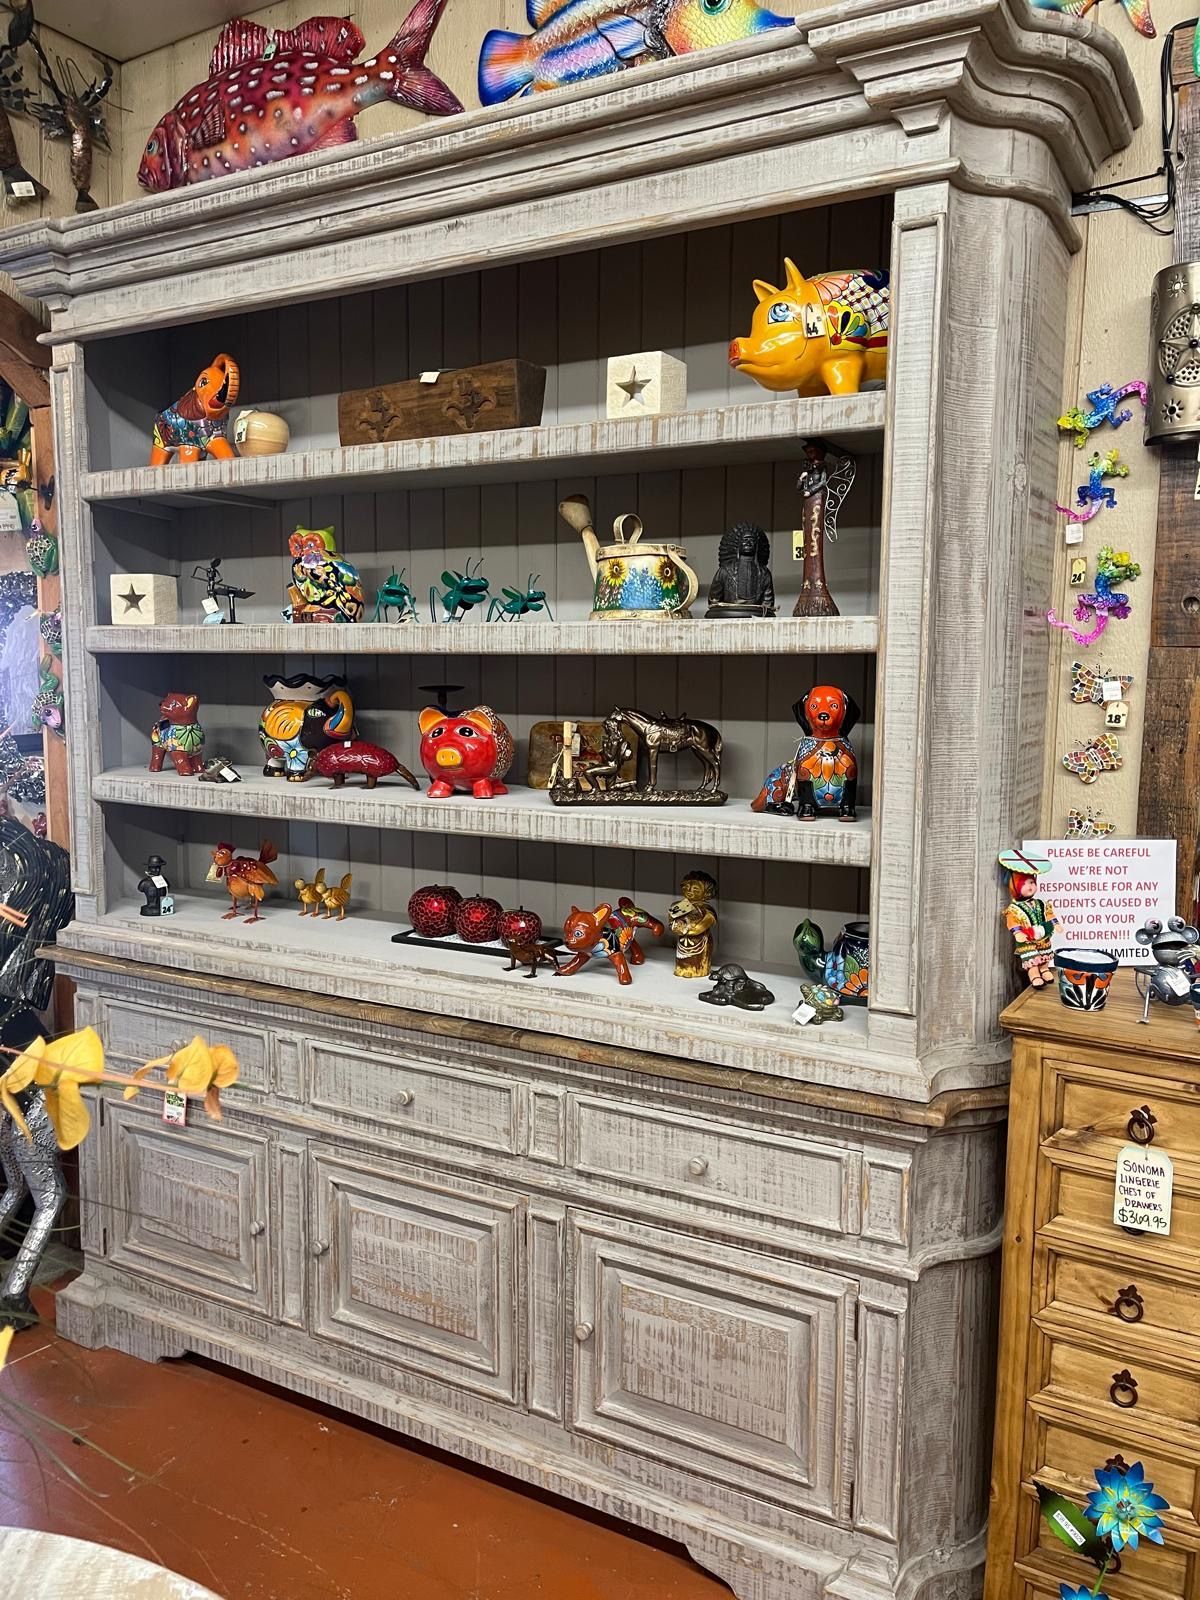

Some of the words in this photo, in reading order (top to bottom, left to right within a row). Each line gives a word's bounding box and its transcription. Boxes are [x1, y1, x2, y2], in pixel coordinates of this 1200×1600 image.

[1107, 714, 1121, 724] 18
[1047, 848, 1084, 858] PLEASE
[1087, 848, 1100, 858] BE
[1103, 847, 1151, 857] CAREFUL
[1068, 865, 1102, 875] WE'RE
[1105, 865, 1128, 875] NOT
[1040, 882, 1108, 892] RESPONSIBLE
[1111, 882, 1132, 891] FOR
[1135, 881, 1159, 891] ANY
[1047, 898, 1096, 908] CIDENTS
[1099, 898, 1141, 908] CAUSED
[1145, 897, 1159, 907] BY
[1061, 915, 1083, 924] YOU
[1086, 914, 1102, 924] OR
[1105, 914, 1135, 924] YOUR
[1065, 930, 1130, 941] CHILDREN!!!
[1123, 1160, 1165, 1177] SONOMA
[1120, 1173, 1160, 1188] LINGERIE
[1119, 1185, 1141, 1196] CHEST
[1145, 1191, 1156, 1199] OF
[1124, 1198, 1162, 1211] DRAWERS
[1118, 1207, 1167, 1229] $369.95
